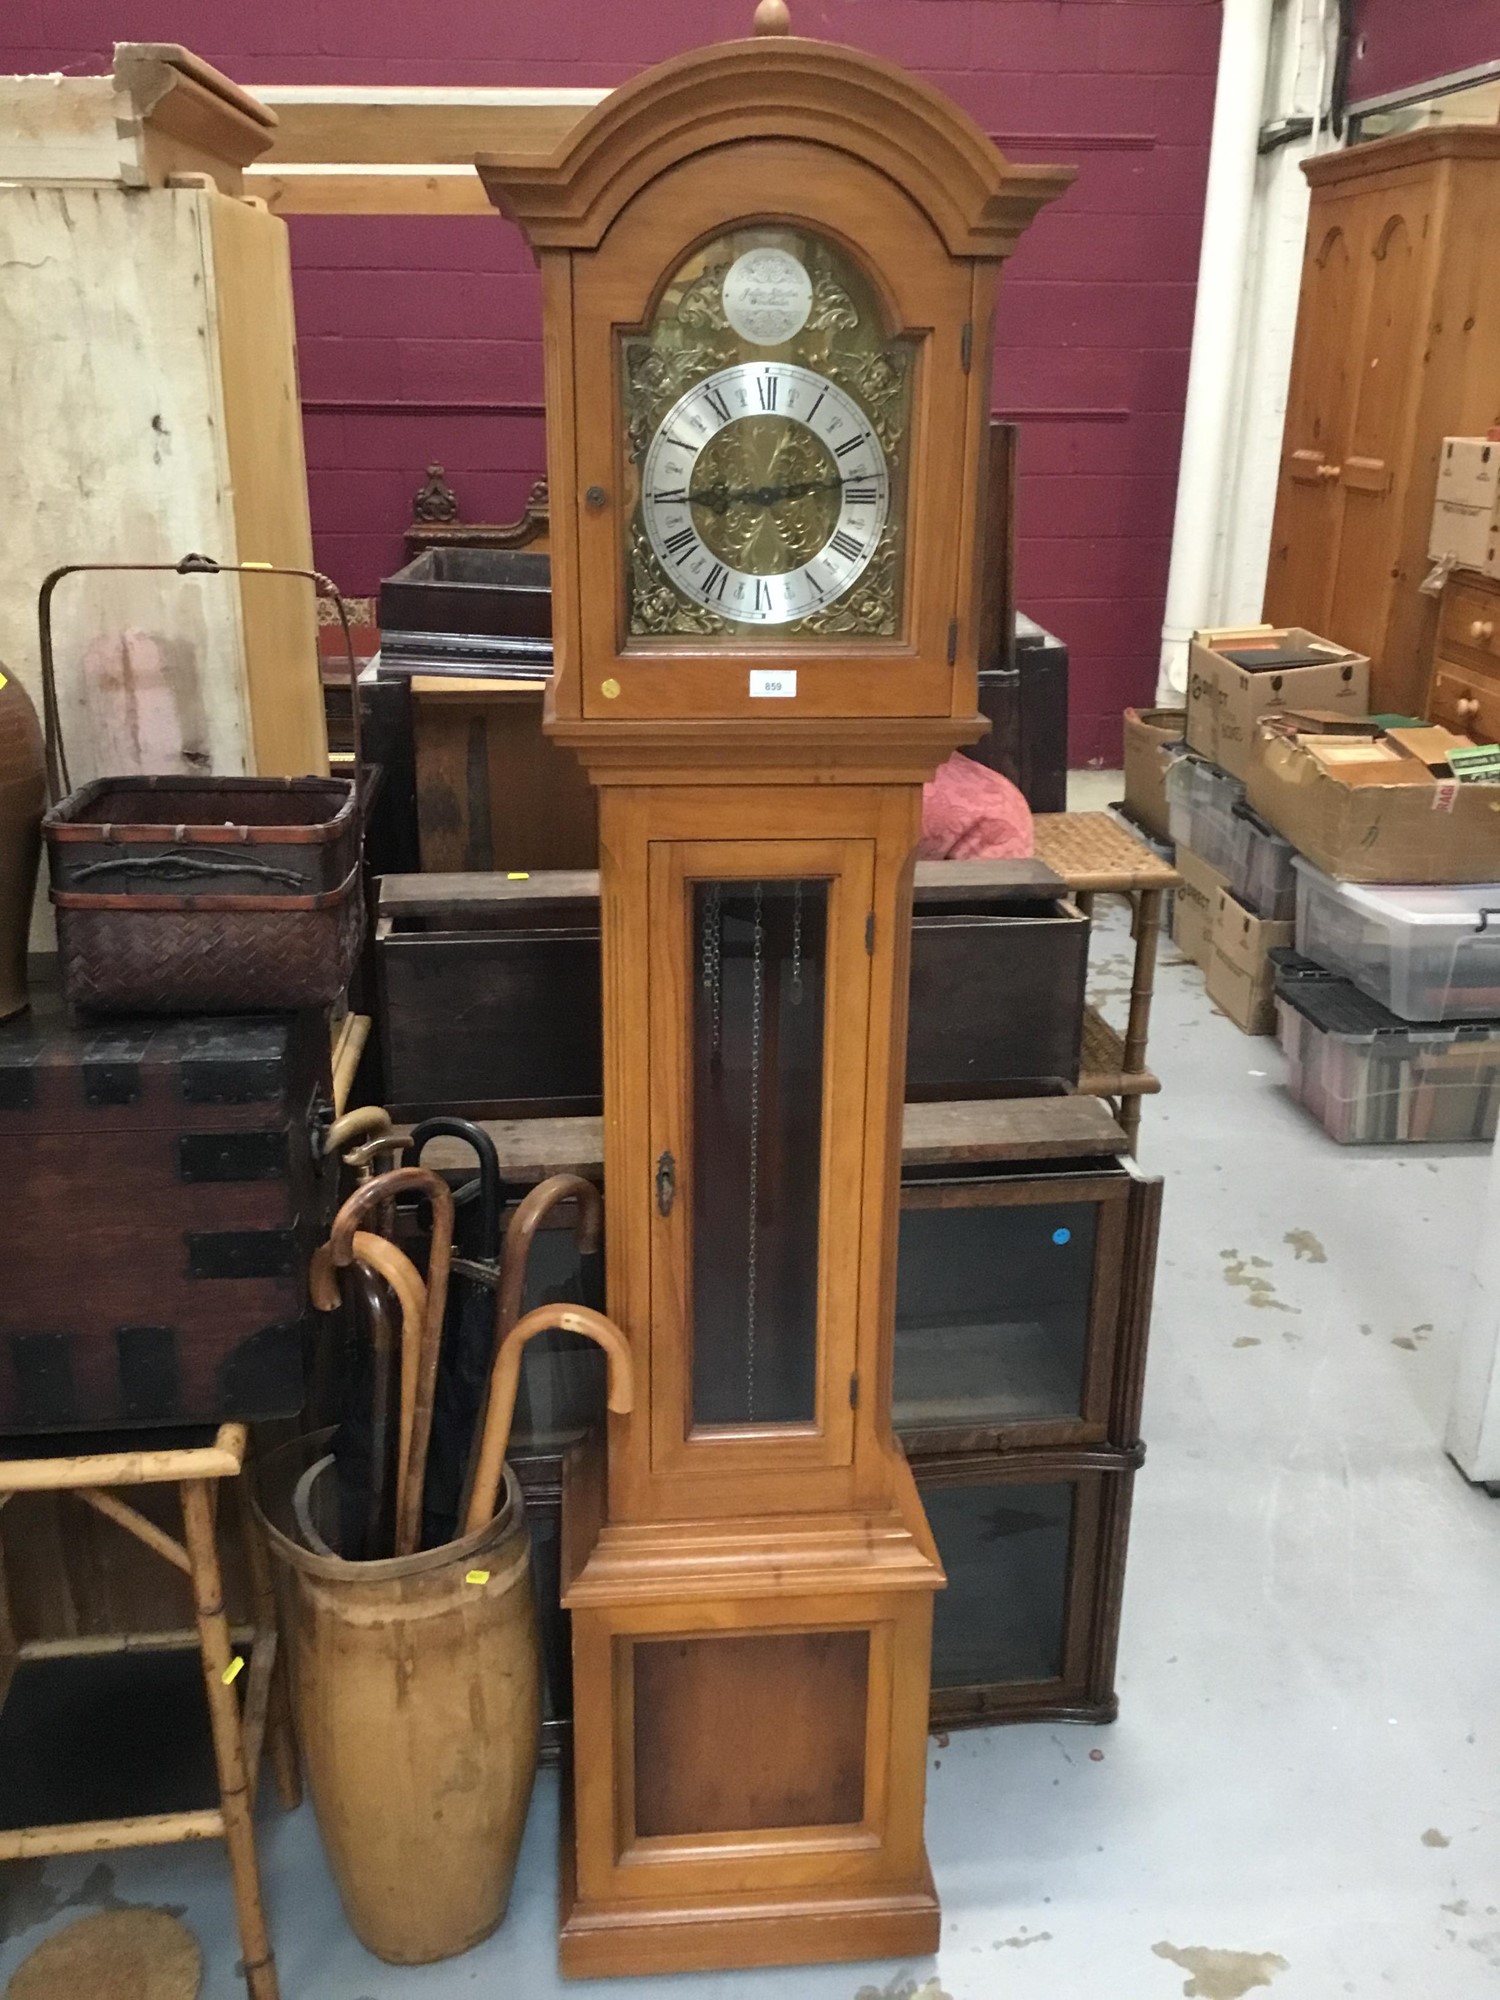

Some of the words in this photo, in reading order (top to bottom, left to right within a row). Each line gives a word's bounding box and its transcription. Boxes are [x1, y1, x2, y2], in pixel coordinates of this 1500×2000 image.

[834, 434, 865, 458] II
[845, 488, 877, 505] III
[765, 682, 782, 691] 859
